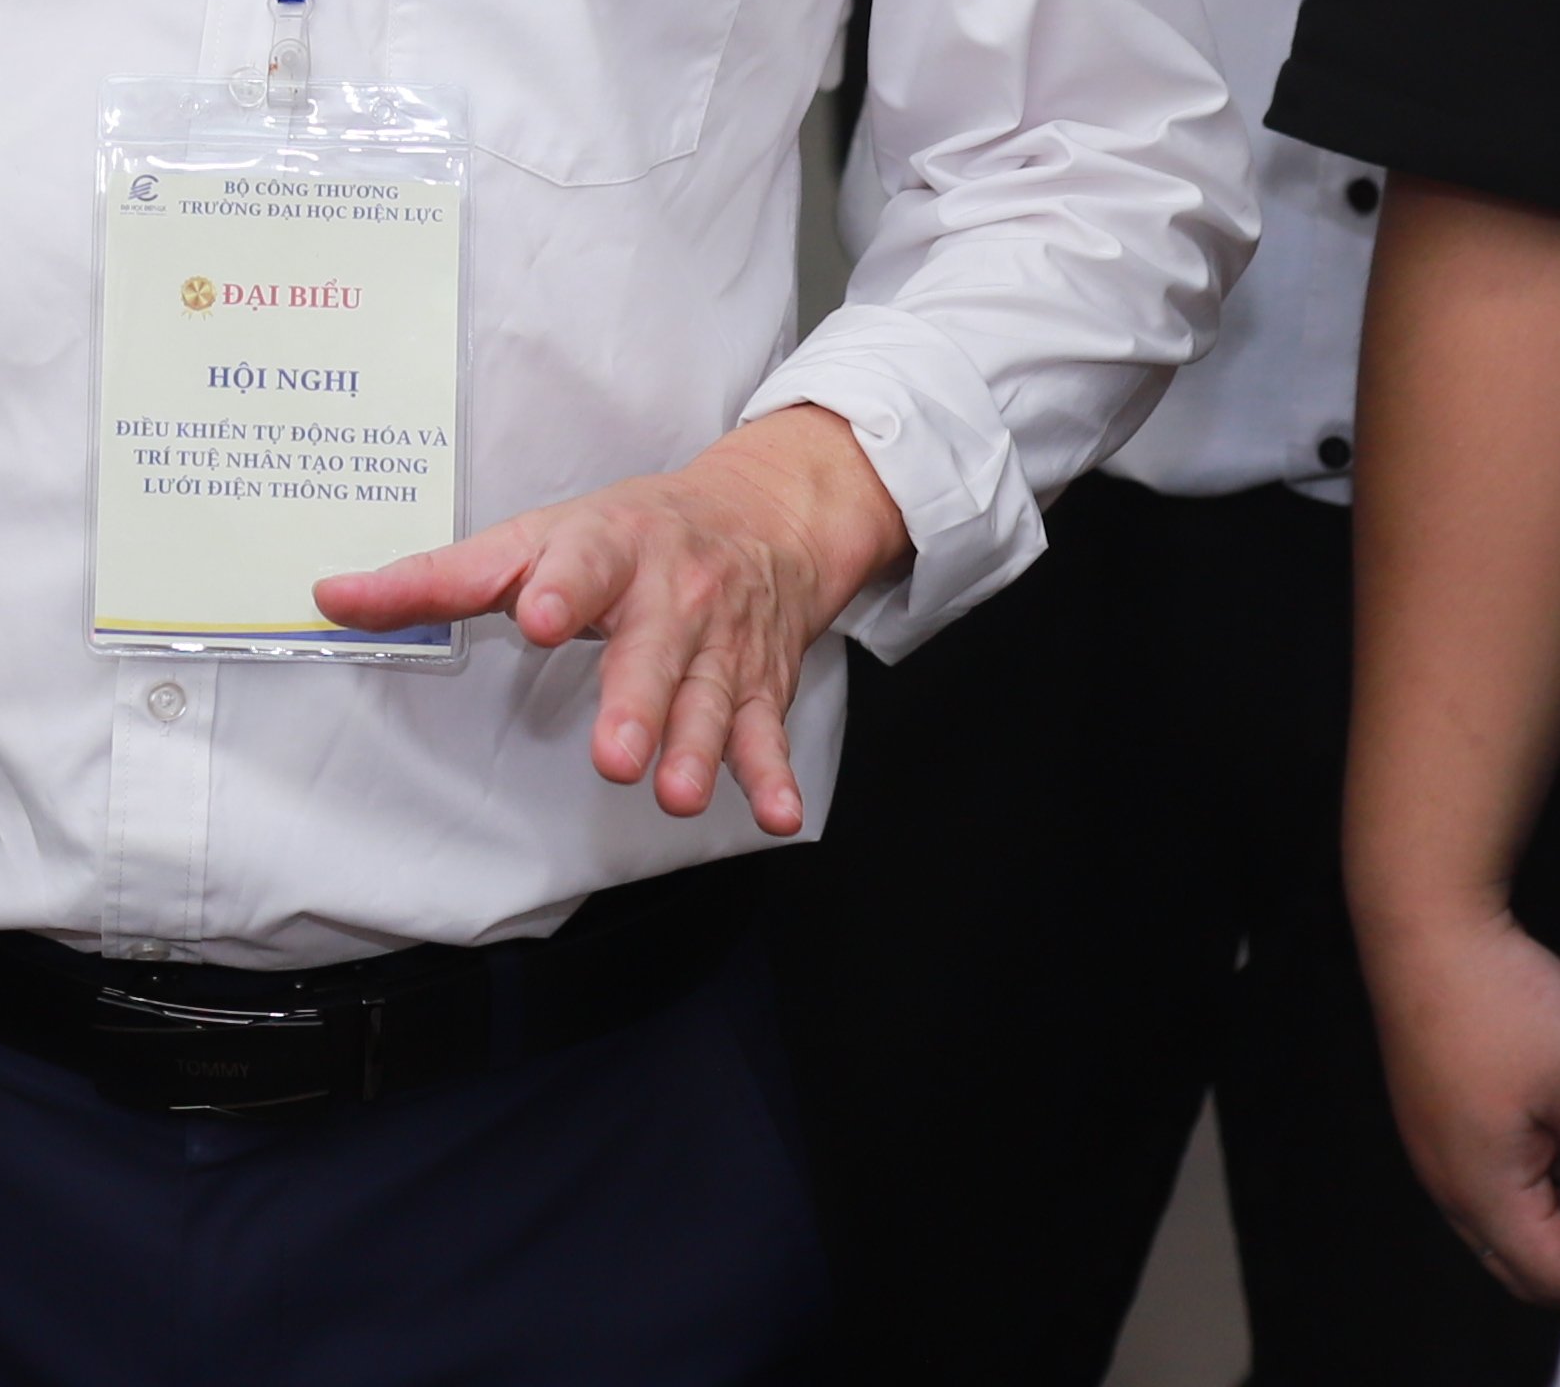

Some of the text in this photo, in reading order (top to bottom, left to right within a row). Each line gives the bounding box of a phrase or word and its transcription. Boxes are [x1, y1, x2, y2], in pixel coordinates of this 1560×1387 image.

[224, 179, 399, 199] BỘ CÔNG THƯƠNG
[179, 199, 443, 225] TRƯỜNG ĐẠI HỌC ĐIỆN LỰC
[222, 278, 362, 311] ĐẠI BIỂU
[208, 361, 359, 398] HỘI NGHỊ
[115, 416, 448, 446] ĐIỀU KHIỂN TỰ ĐỘNG HÓA VÀ
[134, 446, 428, 475] TRÍ TUỆ NHÂN TẠO TRONG
[144, 475, 417, 503] LƯỚI ĐIỆN THÔNG MINH
